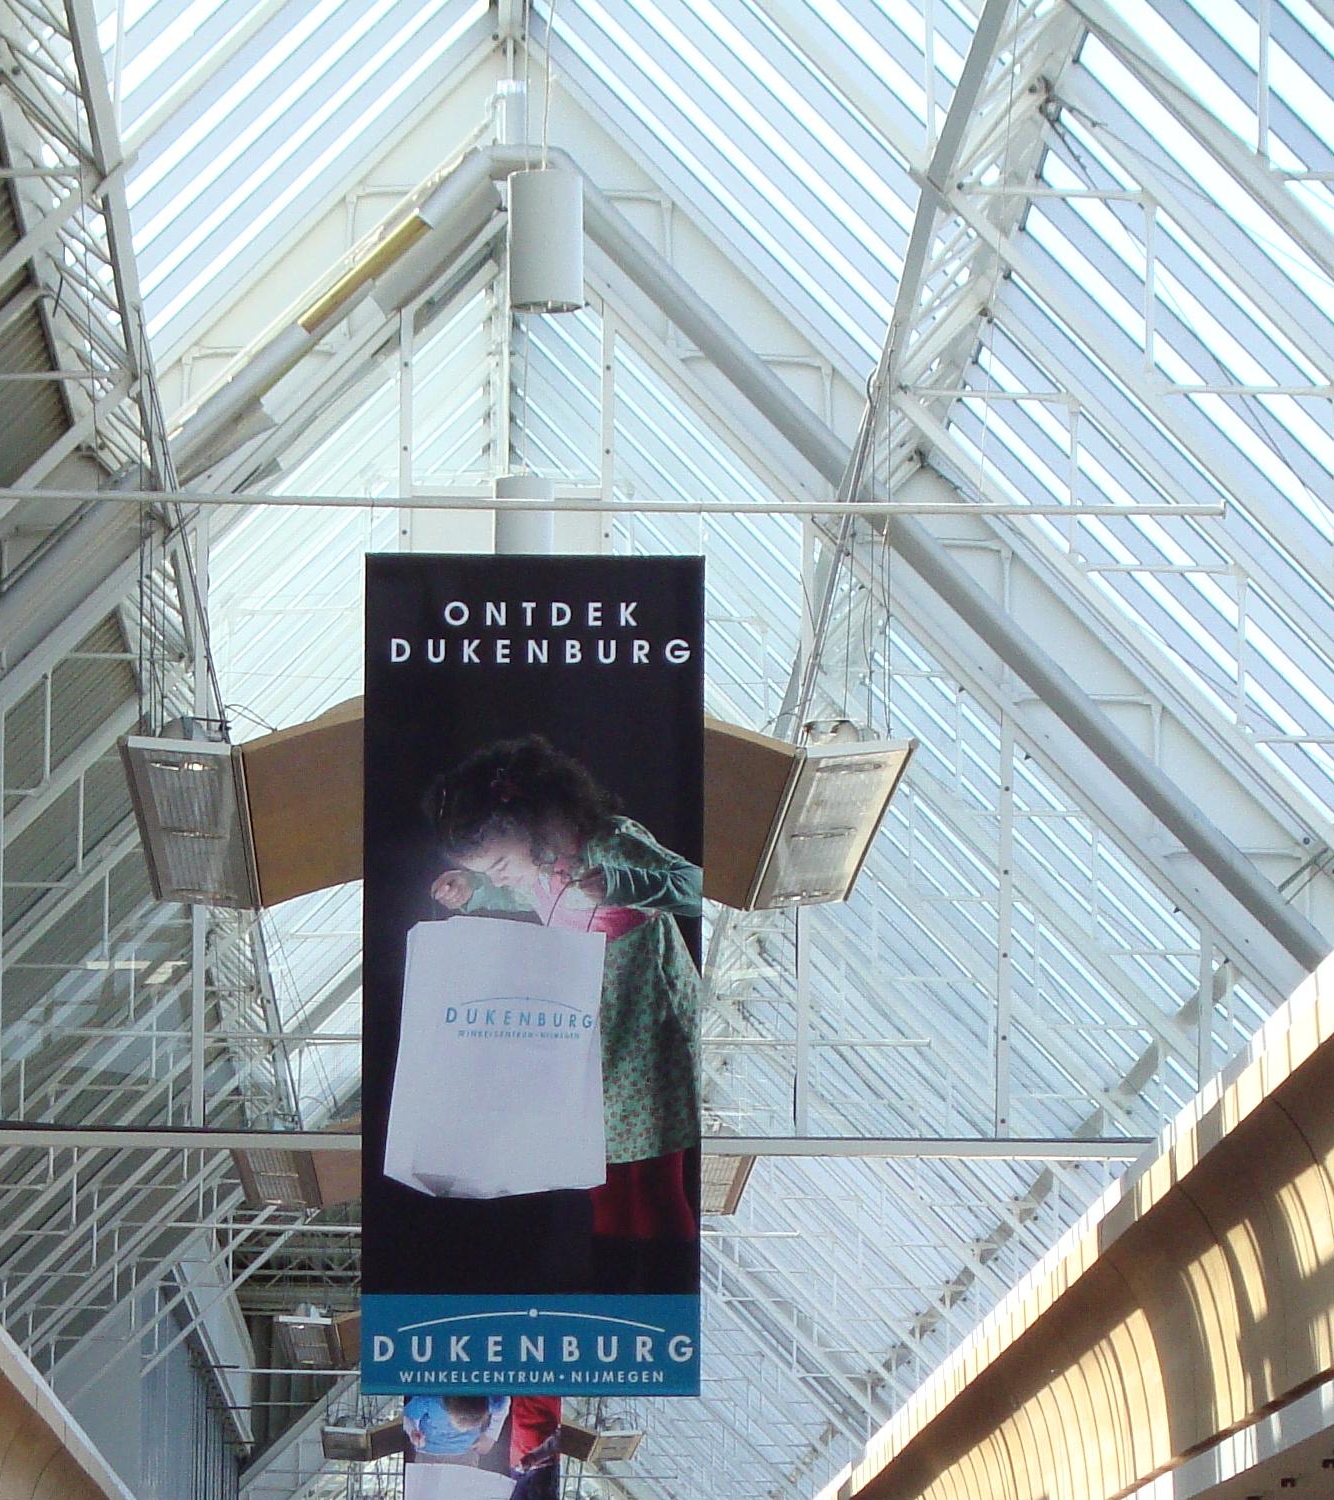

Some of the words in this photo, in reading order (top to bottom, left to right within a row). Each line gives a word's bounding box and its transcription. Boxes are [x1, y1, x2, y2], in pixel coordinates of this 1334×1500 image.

[444, 602, 638, 627] ONTDEK
[390, 639, 691, 664] DUKENBURG
[445, 1007, 593, 1028] DUKENBURG
[373, 1335, 694, 1362] DUKENBURG
[399, 1371, 555, 1383] WINKELCENTRUM
[571, 1371, 664, 1383] NIJMEGEN
